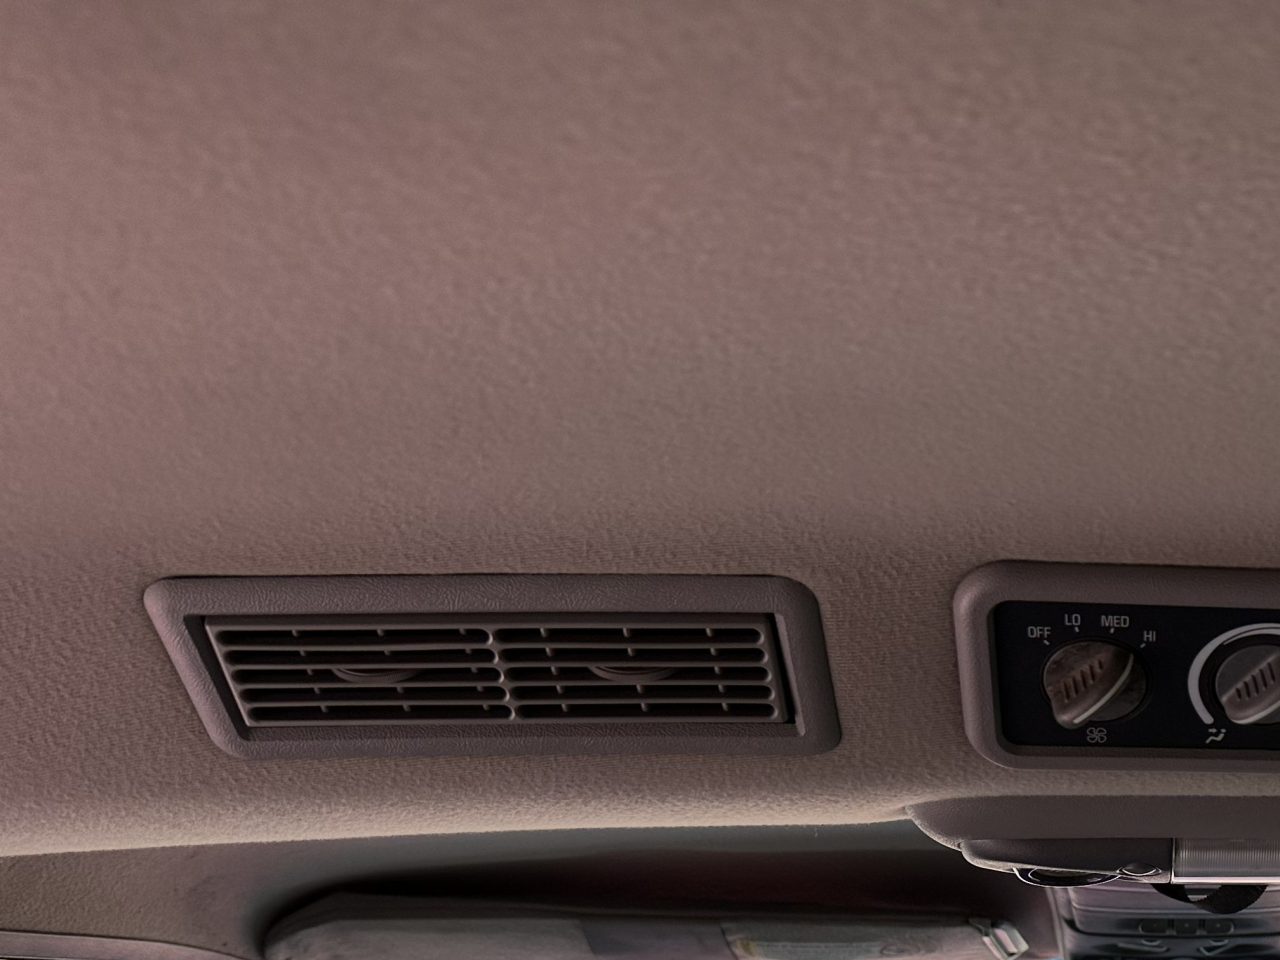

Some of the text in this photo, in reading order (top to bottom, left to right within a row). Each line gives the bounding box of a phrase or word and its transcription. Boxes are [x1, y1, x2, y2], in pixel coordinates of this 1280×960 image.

[1064, 613, 1081, 626] LO
[1100, 615, 1130, 628] MED
[1027, 626, 1051, 638] OFF
[1143, 630, 1156, 642] HI
